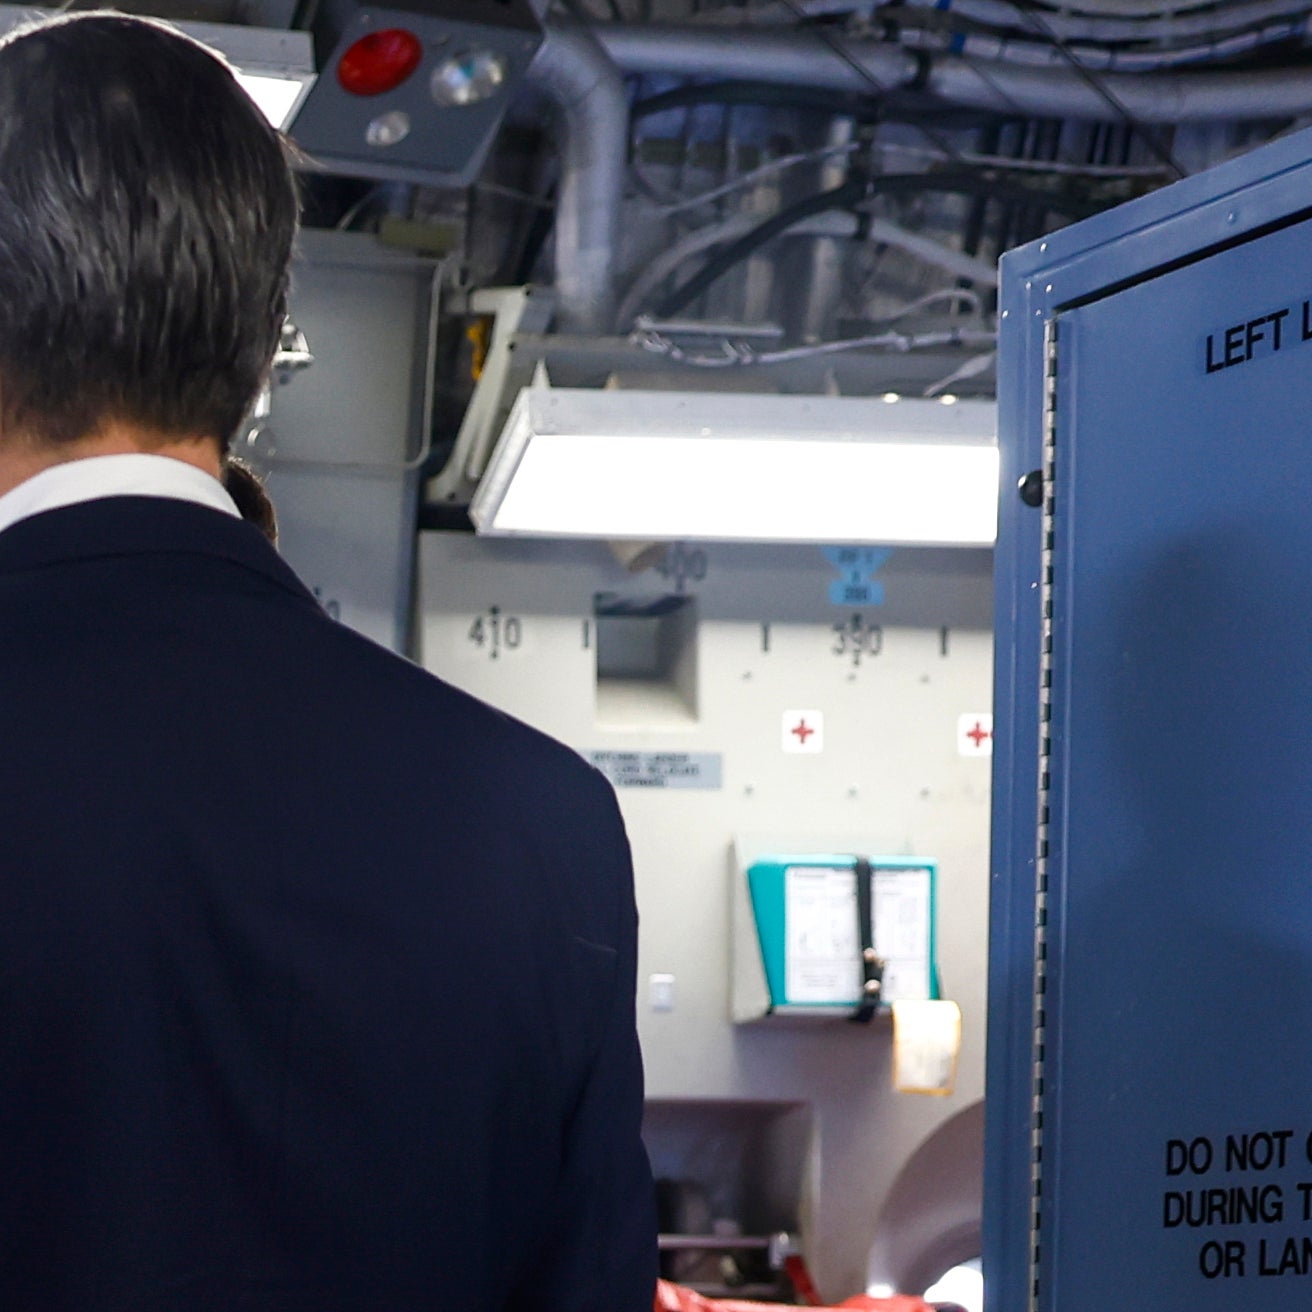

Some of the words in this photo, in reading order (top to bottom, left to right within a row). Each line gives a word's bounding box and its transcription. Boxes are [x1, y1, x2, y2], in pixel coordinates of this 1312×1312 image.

[1205, 307, 1290, 374] LEFT
[468, 615, 523, 649] 410
[832, 621, 884, 655] 390
[1166, 1138, 1213, 1176] DO
[1225, 1130, 1294, 1172] NOT
[1163, 1184, 1284, 1228] DURING
[1199, 1240, 1246, 1280] OR
